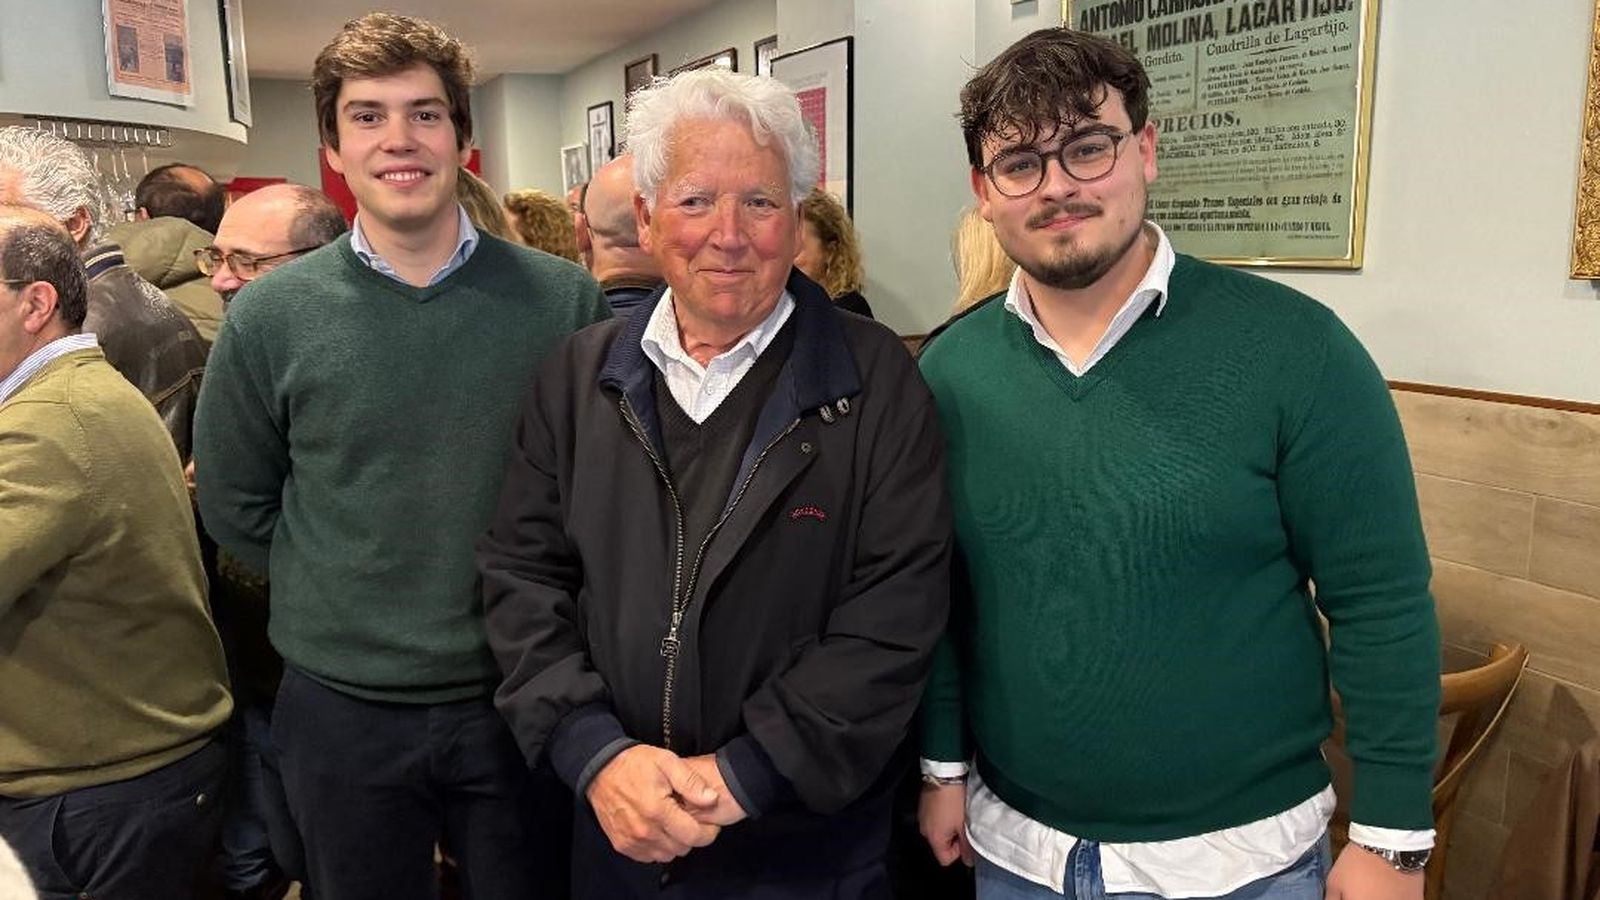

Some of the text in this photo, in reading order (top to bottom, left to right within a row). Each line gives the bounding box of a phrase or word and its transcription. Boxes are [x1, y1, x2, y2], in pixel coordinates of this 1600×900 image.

[1081, 0, 1225, 31] ANTONIO CARM
[1147, 12, 1218, 51] MOLINA,
[1206, 19, 1349, 56] Cuadrilla de Lagartijo.
